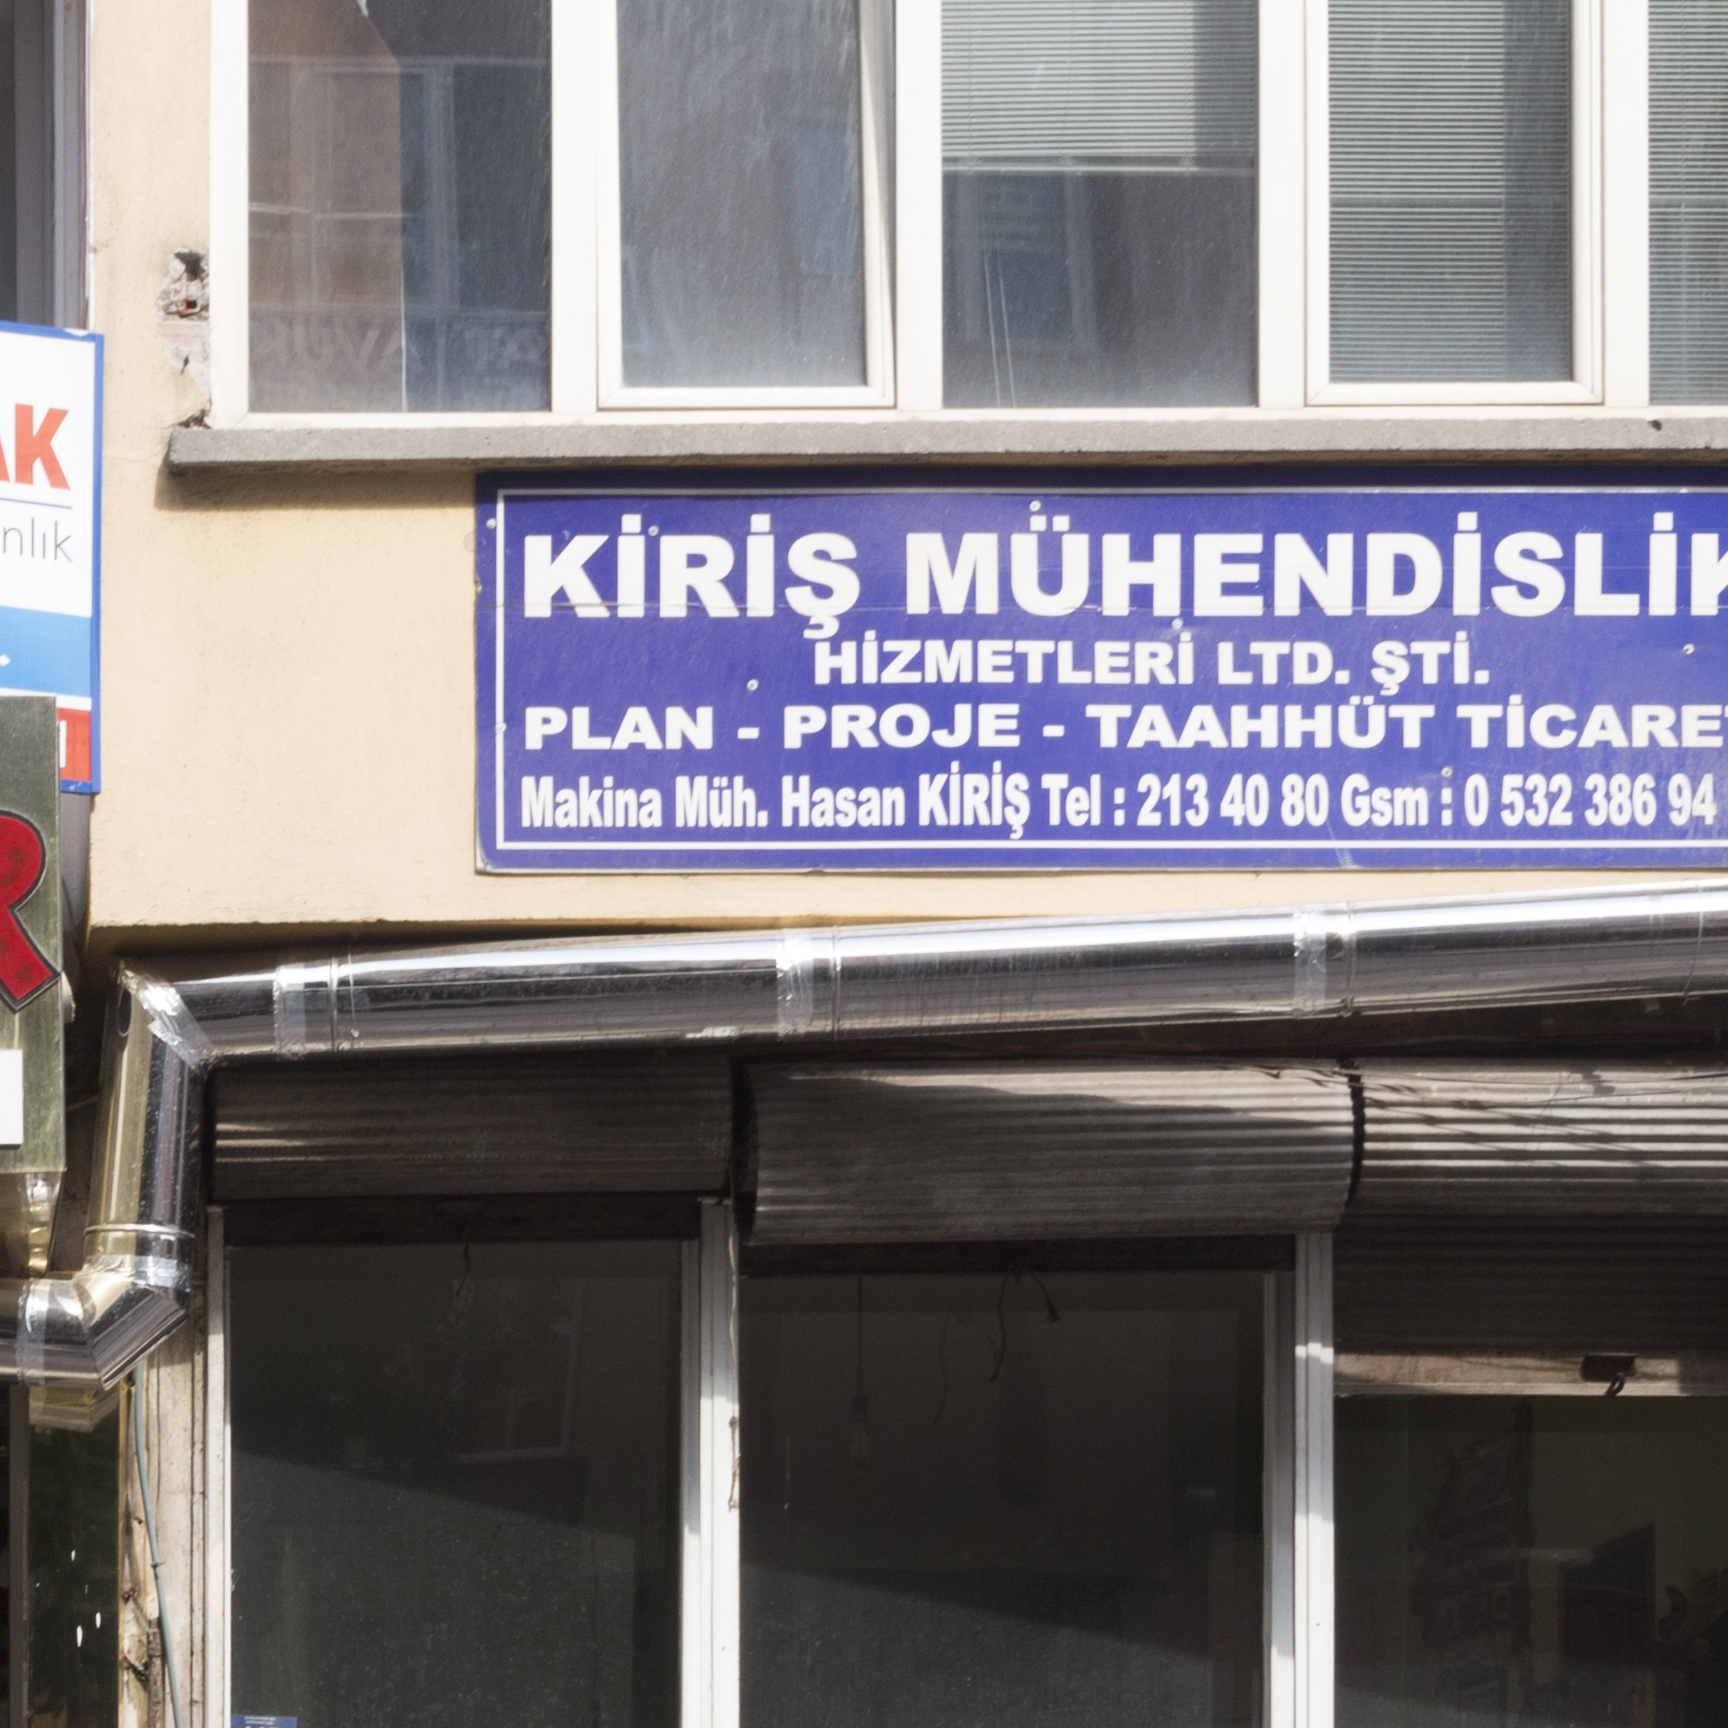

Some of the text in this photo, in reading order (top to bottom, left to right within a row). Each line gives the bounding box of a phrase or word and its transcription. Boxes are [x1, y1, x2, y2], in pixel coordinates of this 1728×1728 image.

[522, 511, 1728, 639] KİRİŞ MÜHENDİSLİK
[815, 630, 1489, 697] HİZMETLERİ LTD. ŞTİ.
[524, 707, 715, 751] PLAN
[785, 705, 1020, 750] PROJE
[1086, 696, 1437, 749] TAAHHÜT
[1457, 694, 1728, 748] TİCARE
[521, 775, 663, 828] Makina
[676, 775, 769, 828] Müh.
[782, 775, 905, 827] Hasan
[918, 761, 1031, 838] KİRİŞ
[1136, 773, 1210, 827] 213
[1219, 773, 1270, 827] 40
[1280, 773, 1329, 827] 80
[1341, 773, 1429, 827] Gsm
[1464, 773, 1489, 827] 0
[1500, 773, 1573, 827] 532
[1584, 773, 1657, 827] 386
[1668, 773, 1718, 827] 94
